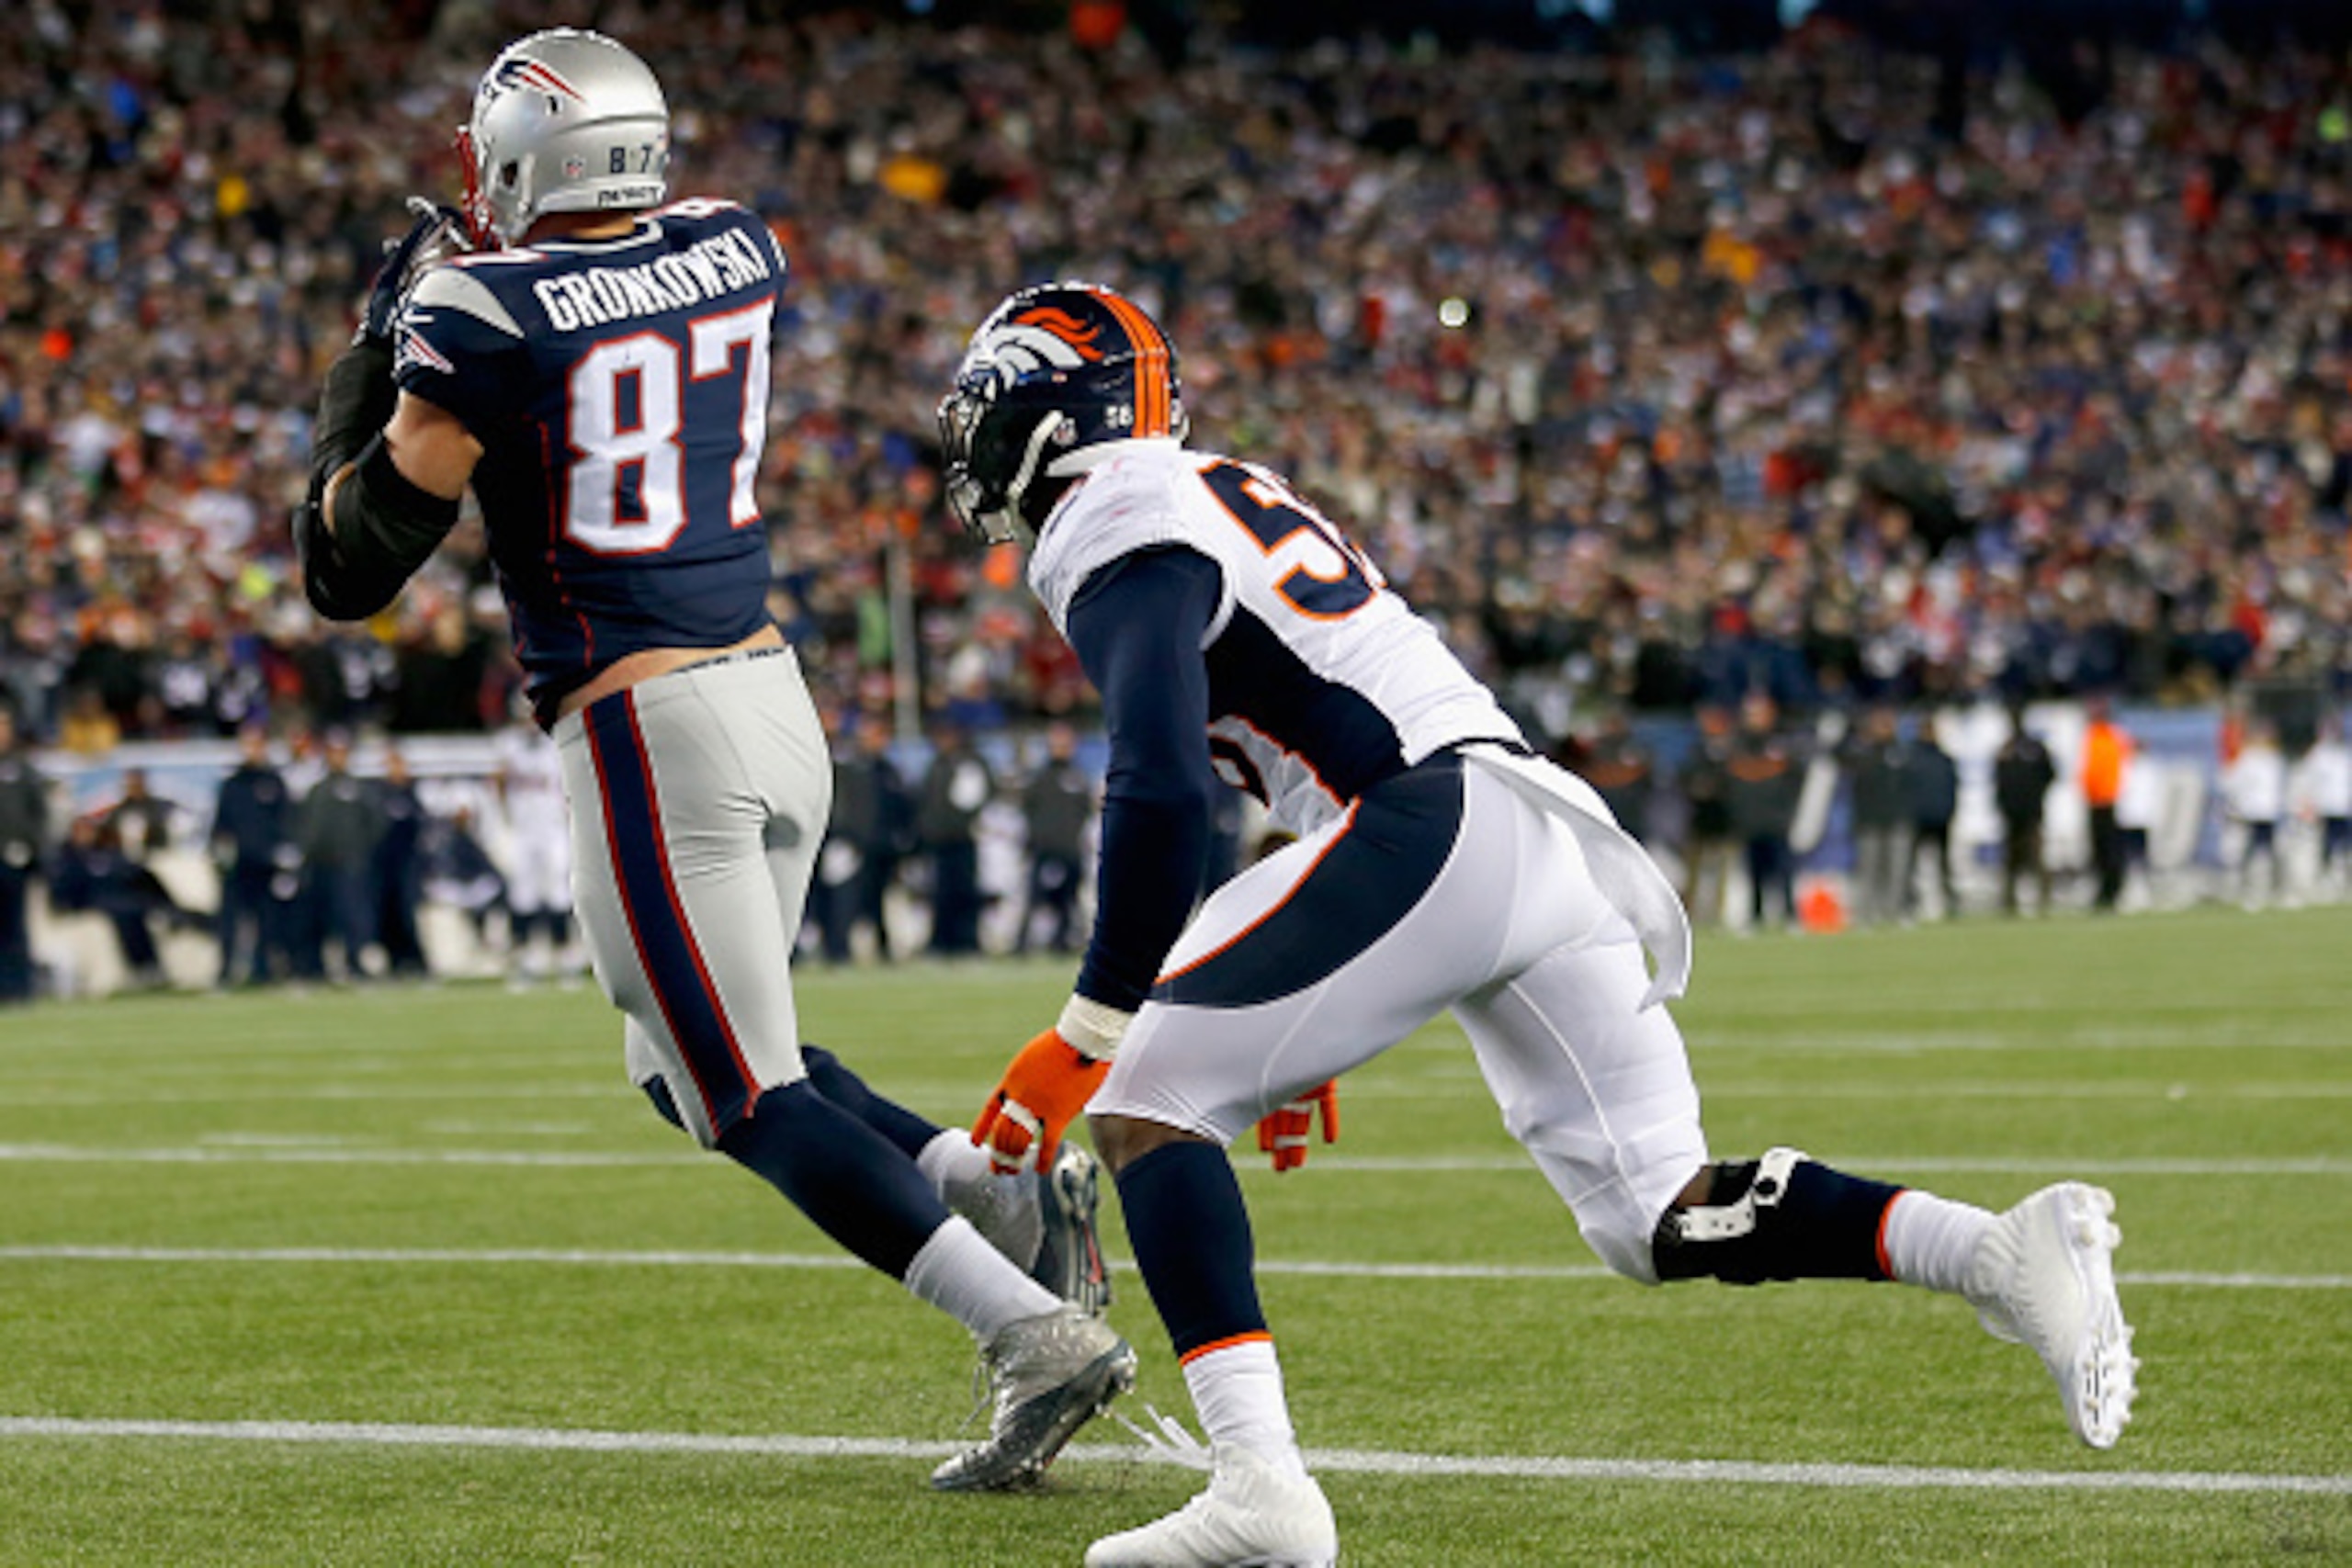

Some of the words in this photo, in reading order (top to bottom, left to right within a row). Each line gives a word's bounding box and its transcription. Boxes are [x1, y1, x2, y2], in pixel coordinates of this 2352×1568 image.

[534, 227, 770, 332] GRONKOWSKI
[561, 293, 776, 557] 87
[1197, 459, 1385, 621] 5
